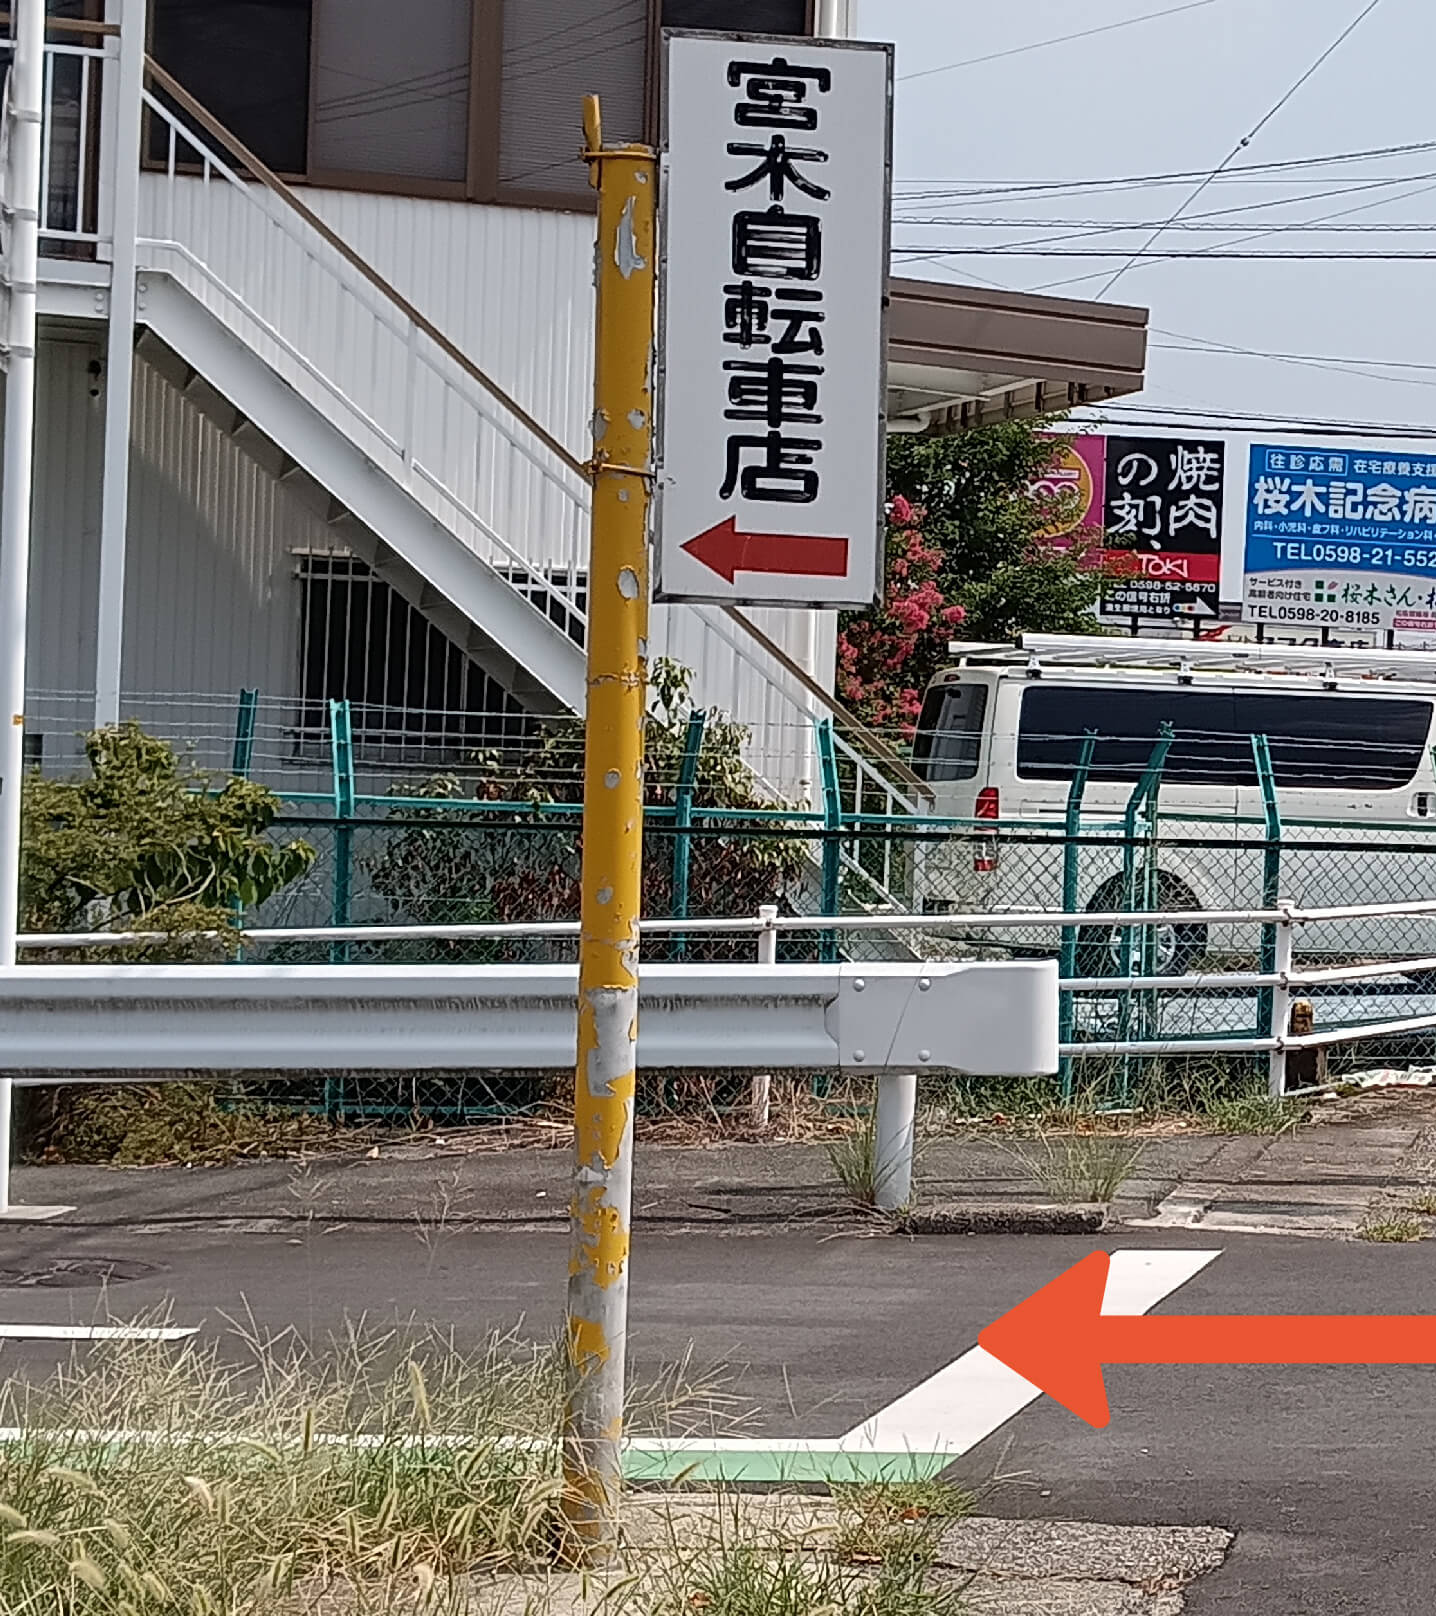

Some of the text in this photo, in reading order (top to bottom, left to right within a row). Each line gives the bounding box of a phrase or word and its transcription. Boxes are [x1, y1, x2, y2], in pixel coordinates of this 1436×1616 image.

[719, 57, 832, 504] 宮木自転車店
[1269, 454, 1344, 473] 往診応需
[1167, 445, 1221, 539] 焼肉
[1138, 553, 1189, 578] TOKI
[1249, 577, 1302, 589] サービス付き
[1248, 604, 1381, 625] TEL0598-20-8185
